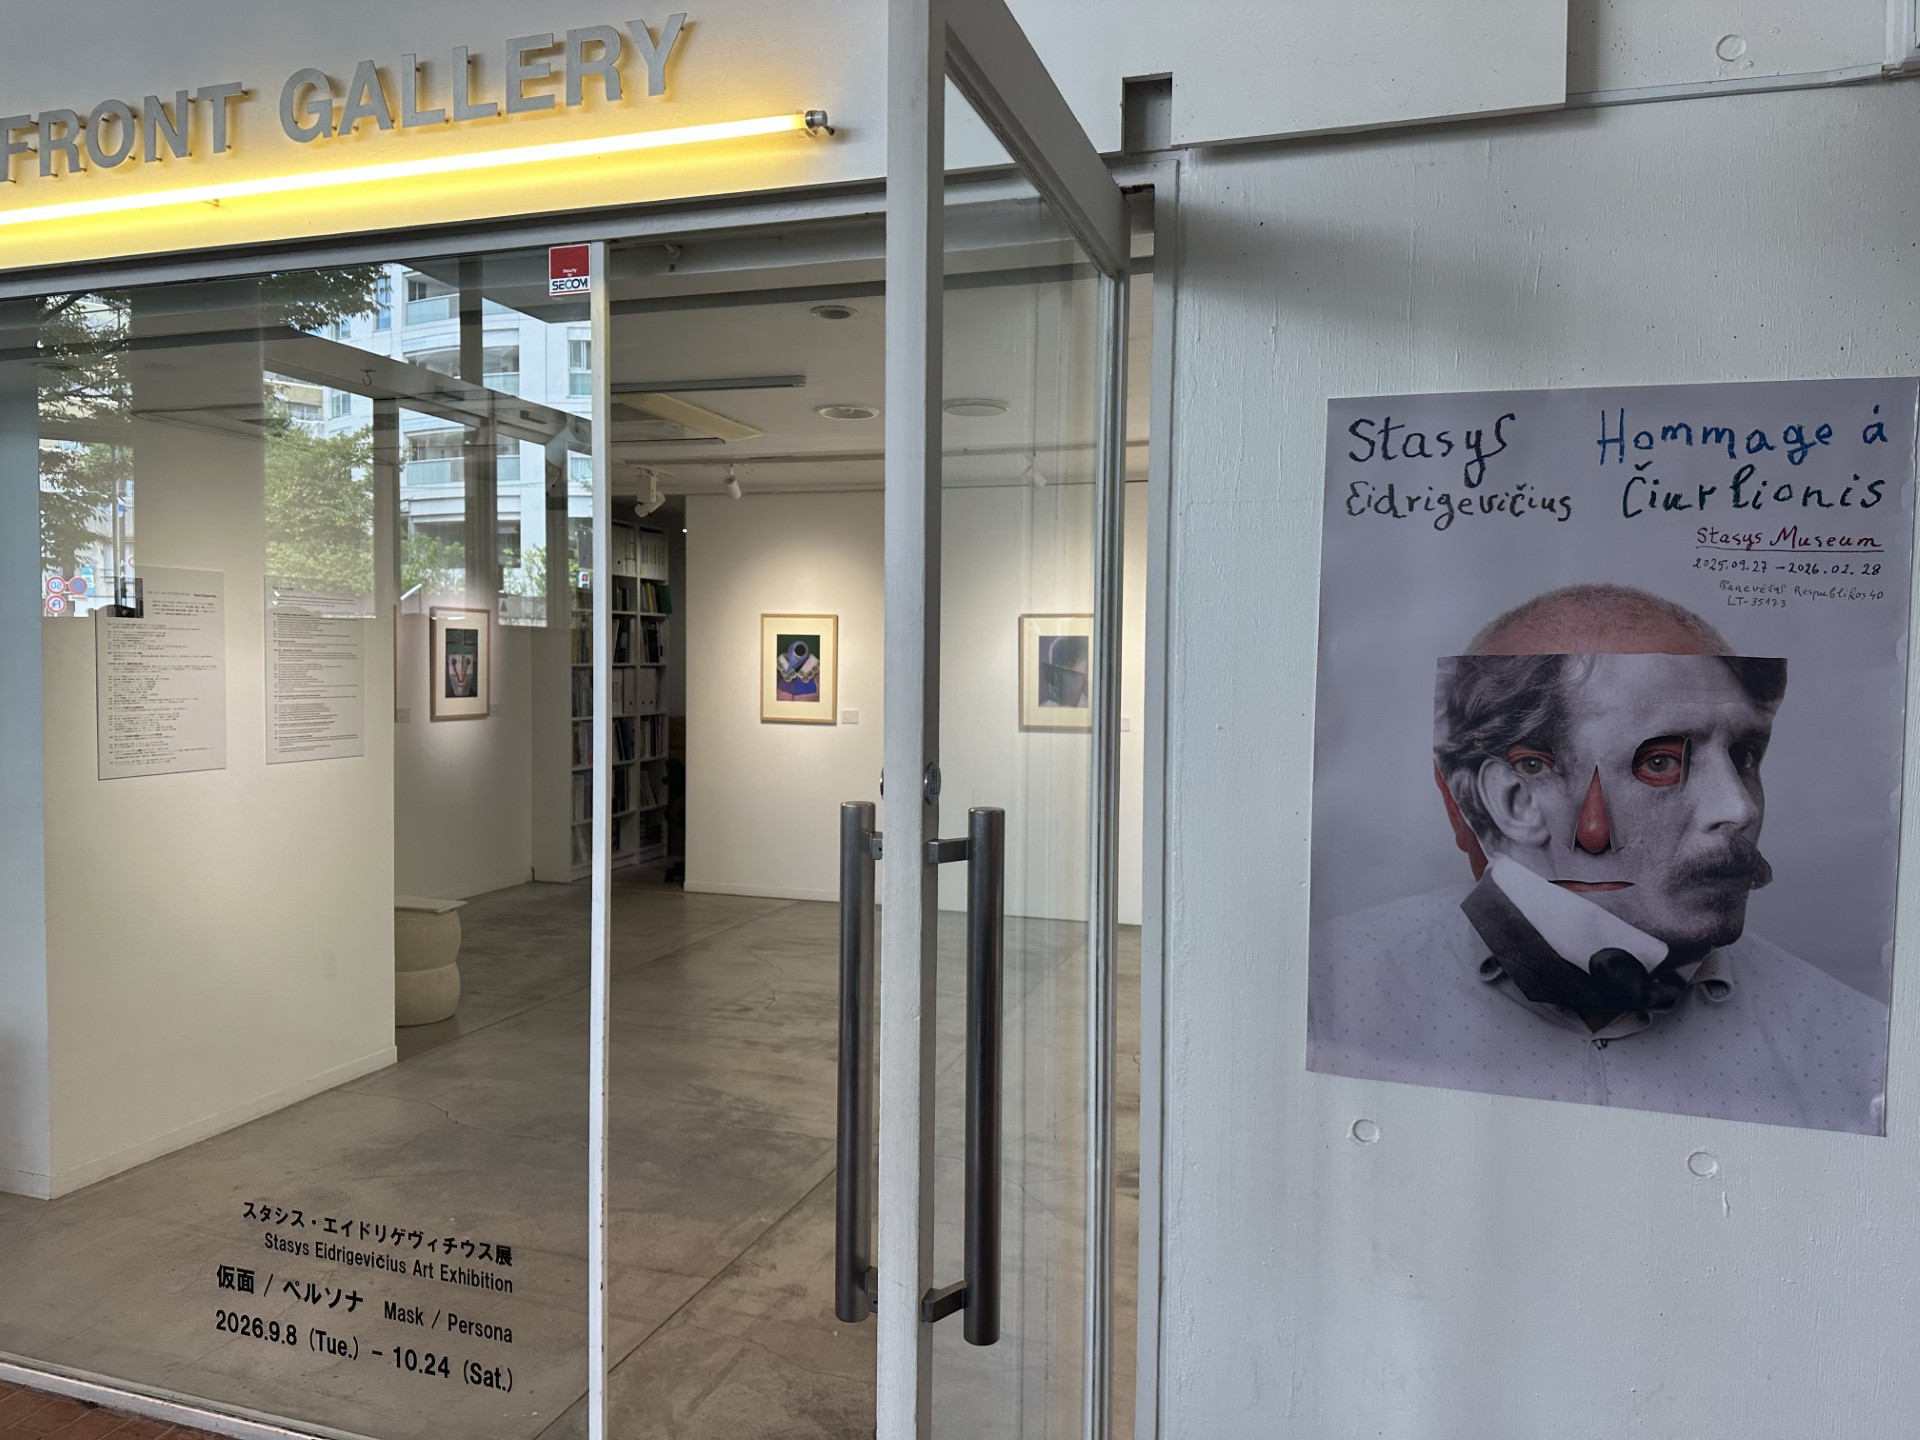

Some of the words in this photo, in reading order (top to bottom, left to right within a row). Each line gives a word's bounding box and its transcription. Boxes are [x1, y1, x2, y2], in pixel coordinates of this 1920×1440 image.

[0, 82, 244, 183] FRONT
[279, 12, 688, 143] GALLERY
[551, 278, 588, 291] SECOM
[1348, 413, 1516, 488] Stasys
[1597, 407, 1833, 465] Hommage
[1346, 480, 1572, 531] Eidrigevičius
[1622, 460, 1885, 519] Čiurlionis
[1696, 526, 1763, 551] Stasys
[1769, 524, 1882, 549] Museum
[242, 1201, 513, 1268] スタシス・エイドリゲヴィチウス展
[264, 1232, 310, 1257] Stasys
[315, 1241, 407, 1275] Eidrigevičius
[412, 1259, 435, 1280] Art
[440, 1263, 513, 1294] Exhibition
[216, 1264, 255, 1295] 仮面
[282, 1280, 364, 1314] ペルソナ
[384, 1300, 424, 1327] Mask
[447, 1313, 513, 1344] Persona
[215, 1309, 298, 1347] 2026.9.8
[309, 1327, 359, 1361] (Tue.)
[392, 1346, 450, 1379] 10.24
[463, 1359, 514, 1394] (Sat.)
